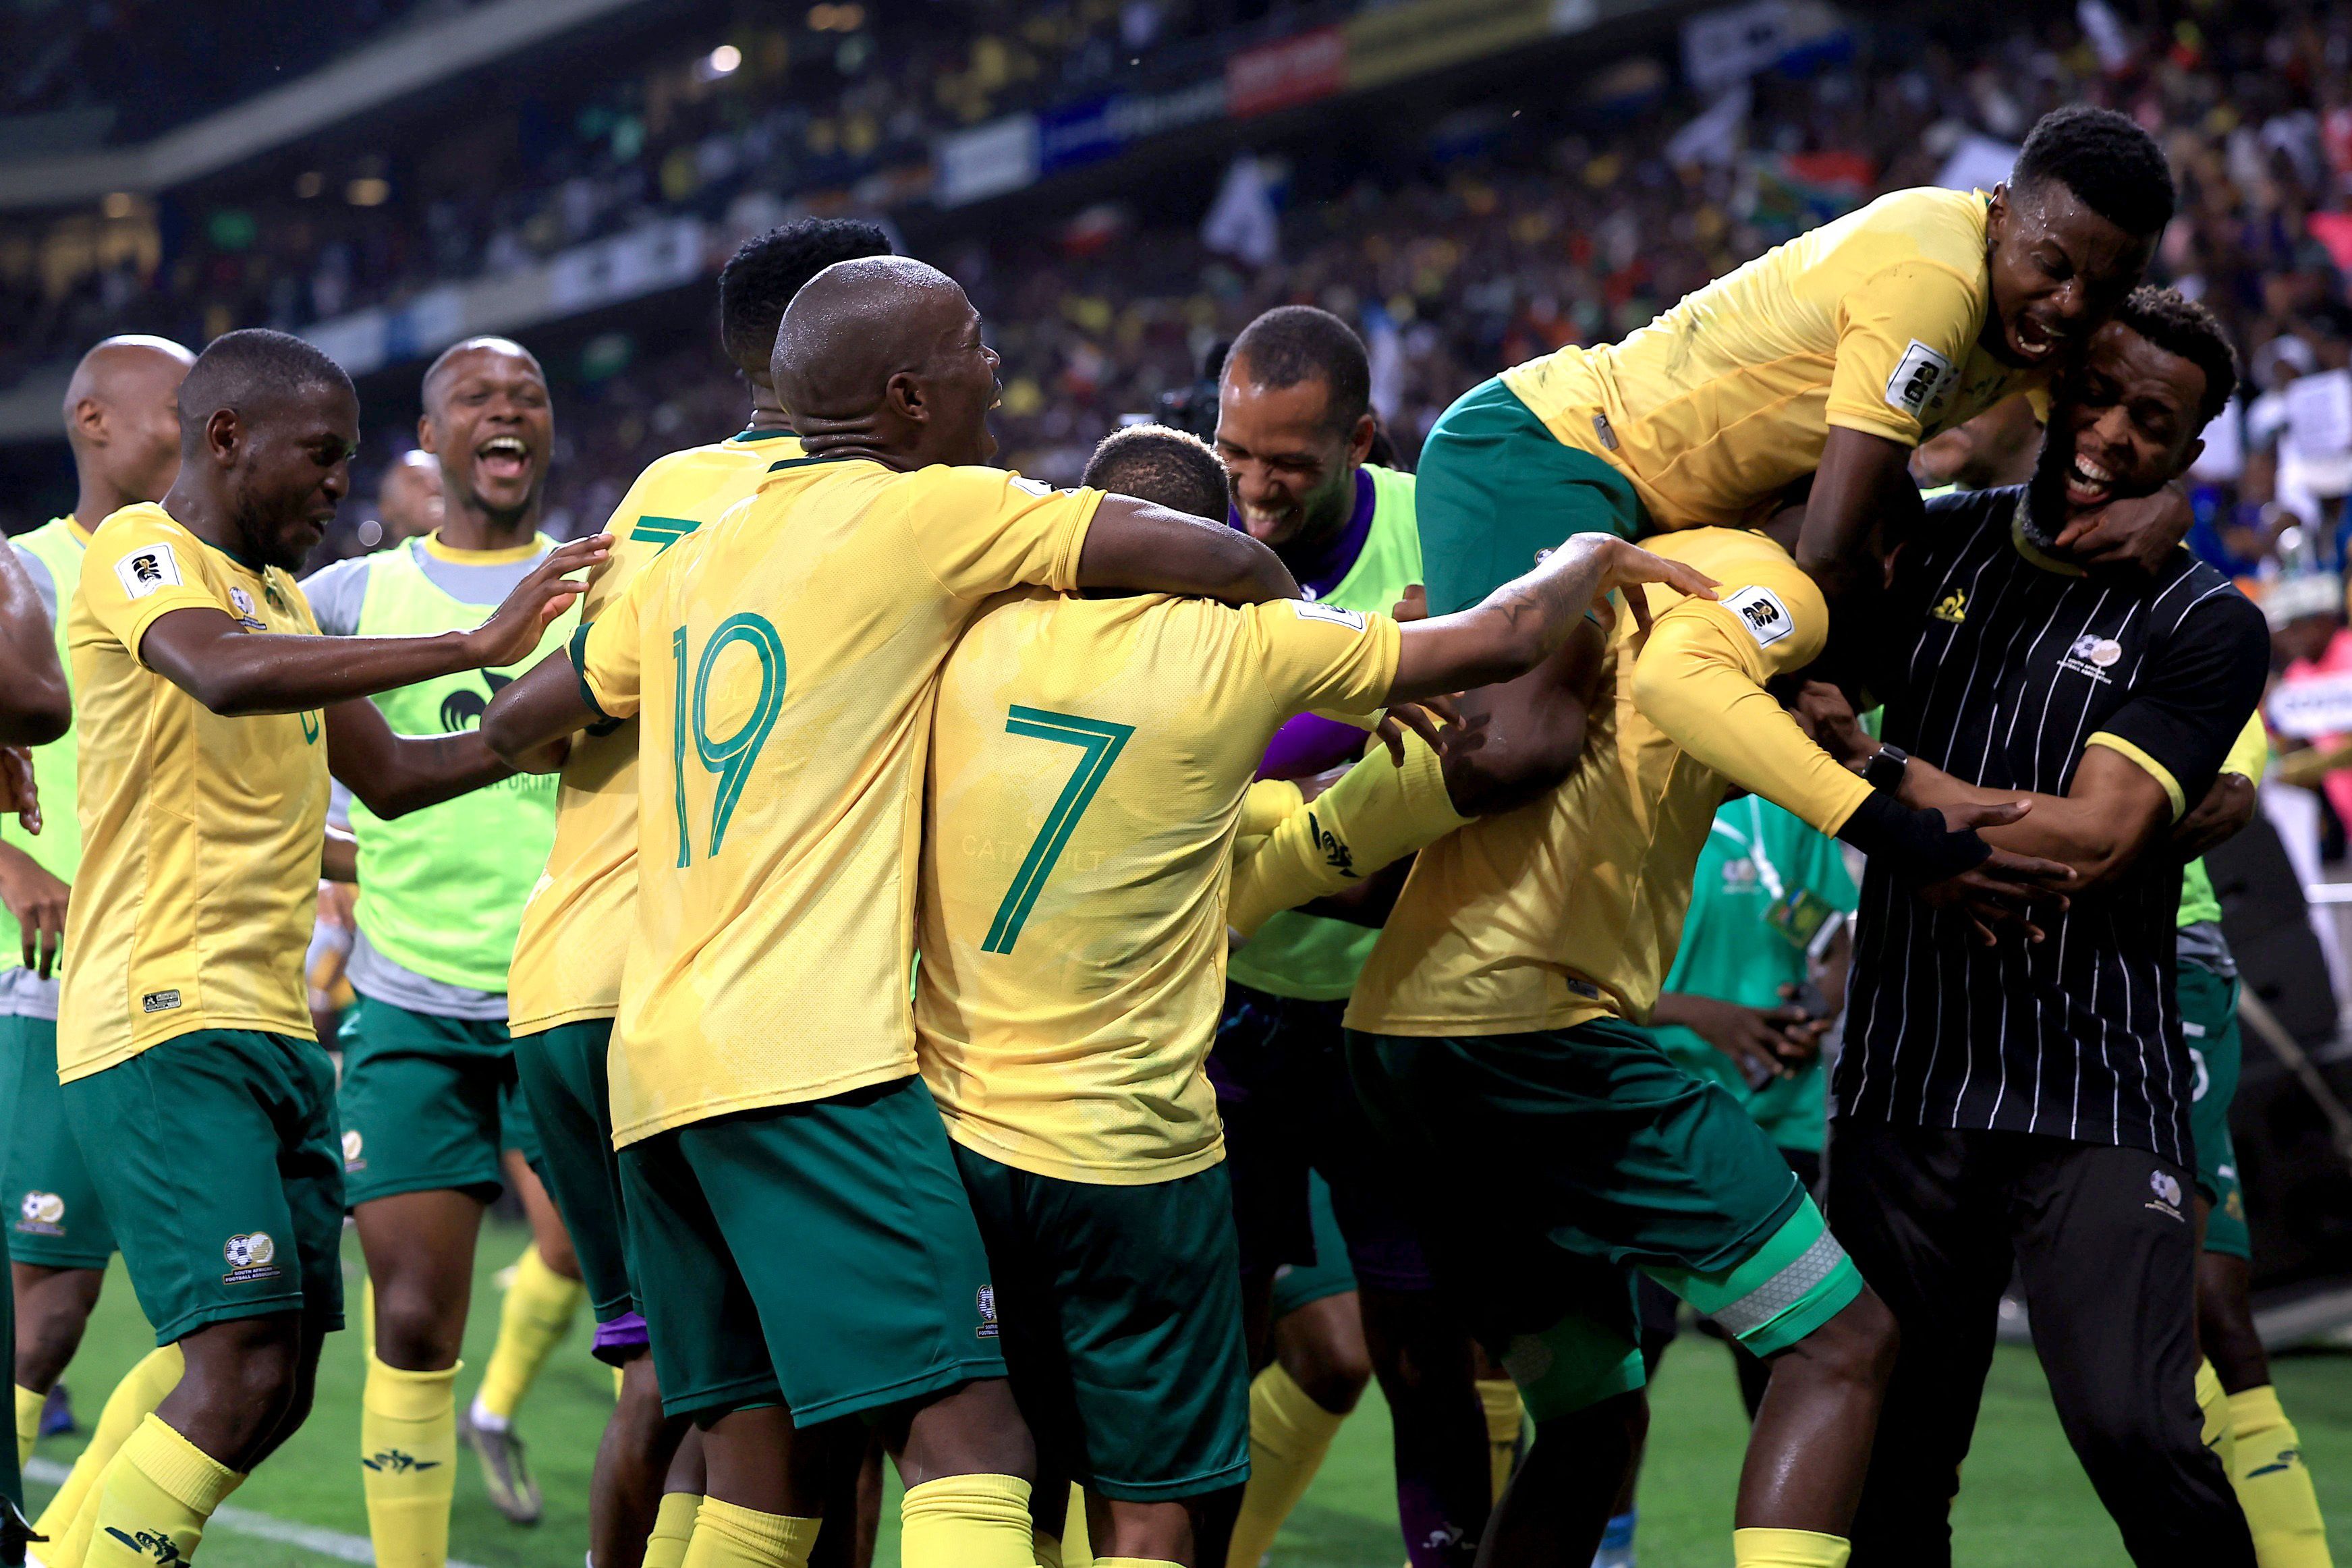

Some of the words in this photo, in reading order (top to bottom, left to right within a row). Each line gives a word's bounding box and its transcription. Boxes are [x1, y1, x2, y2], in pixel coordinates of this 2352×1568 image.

[673, 612, 787, 868] 19
[961, 835, 1107, 872] CATAULT
[980, 704, 1136, 955] 7
[225, 1275, 252, 1283] FOOTBALL
